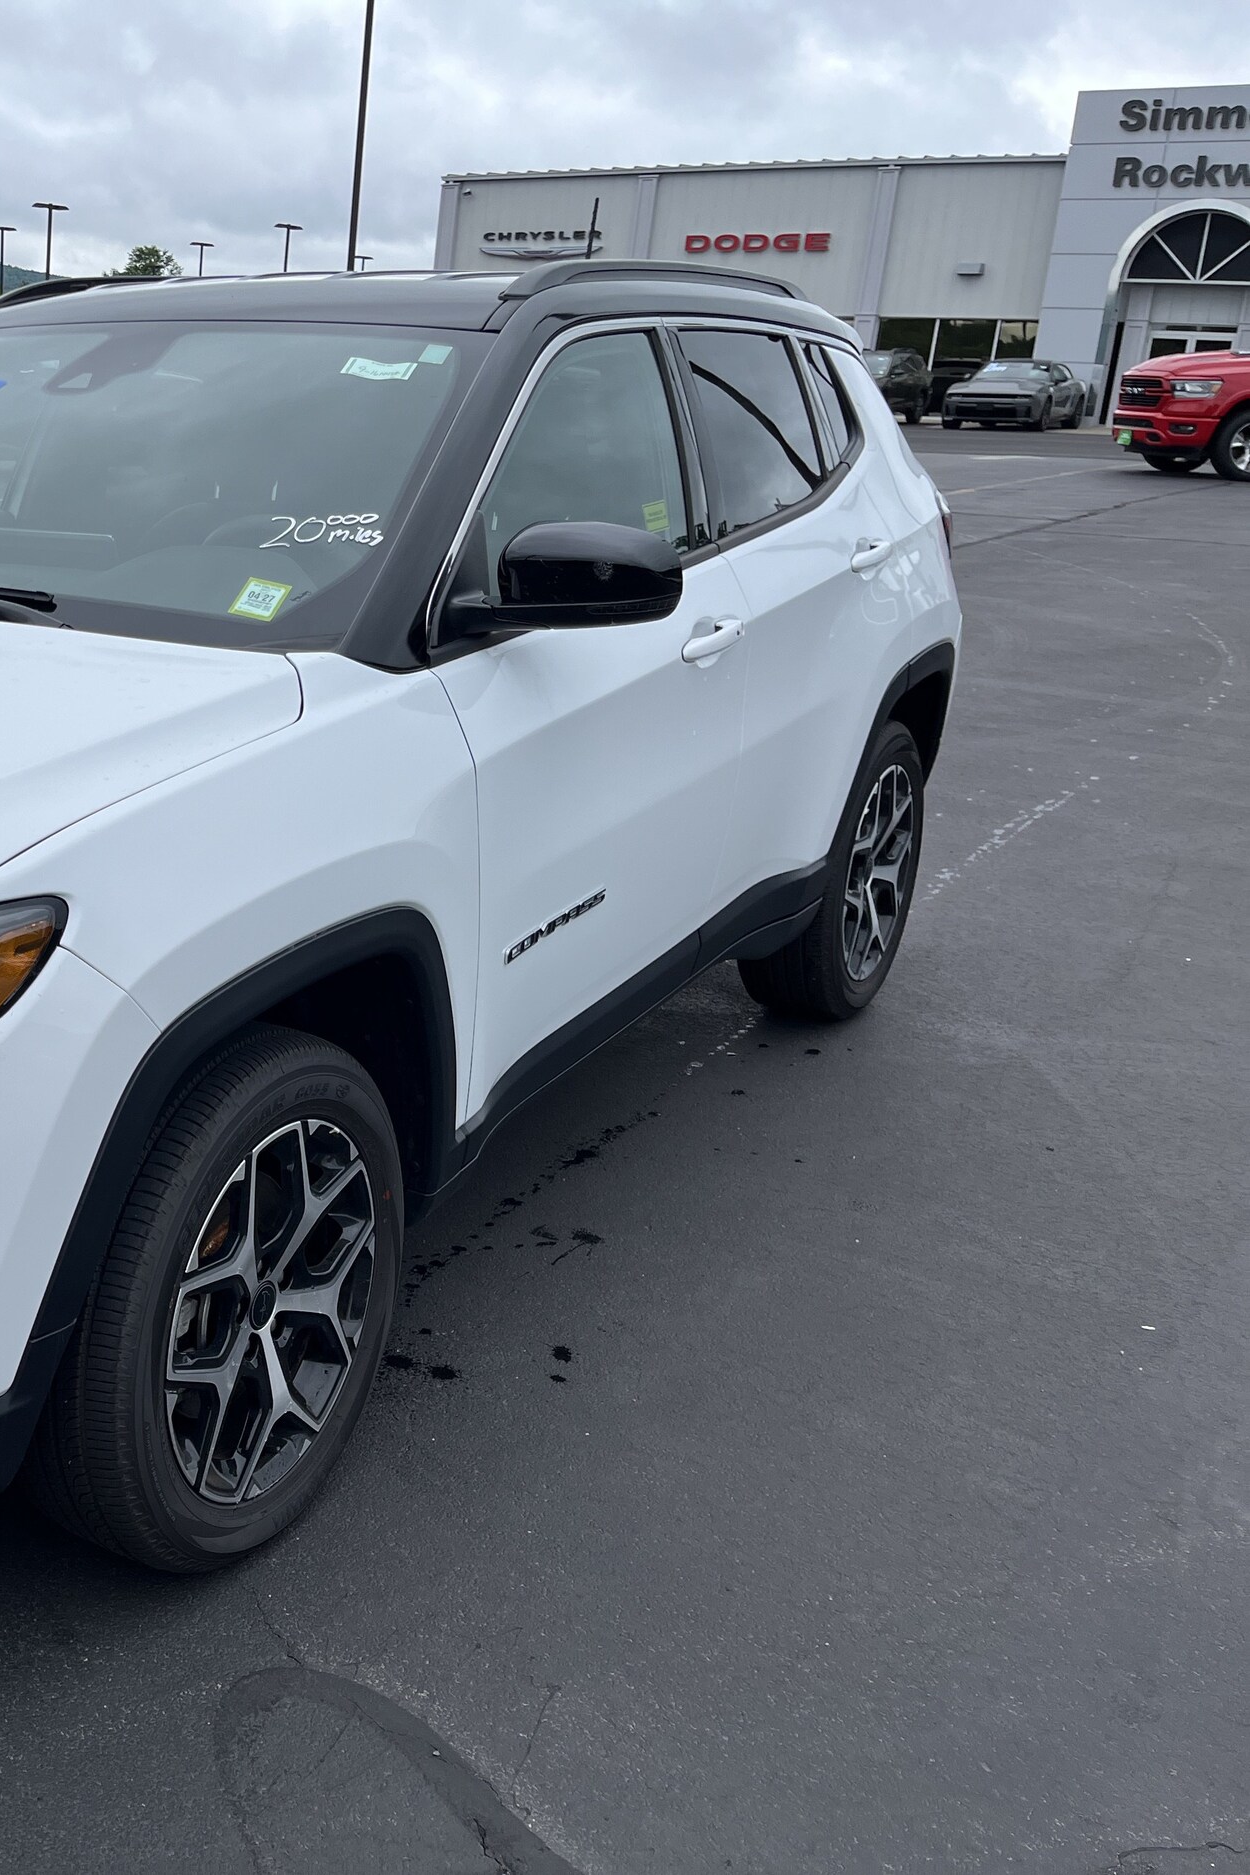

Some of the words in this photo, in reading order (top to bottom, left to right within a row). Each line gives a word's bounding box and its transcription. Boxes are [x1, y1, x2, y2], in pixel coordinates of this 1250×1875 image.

[1119, 99, 1250, 132] Simm
[1112, 155, 1250, 188] Rockw
[483, 230, 602, 241] CHRYSLER
[685, 233, 831, 252] DODGE
[247, 590, 261, 600] 04
[262, 593, 276, 603] 27
[502, 886, 607, 966] COMPASS
